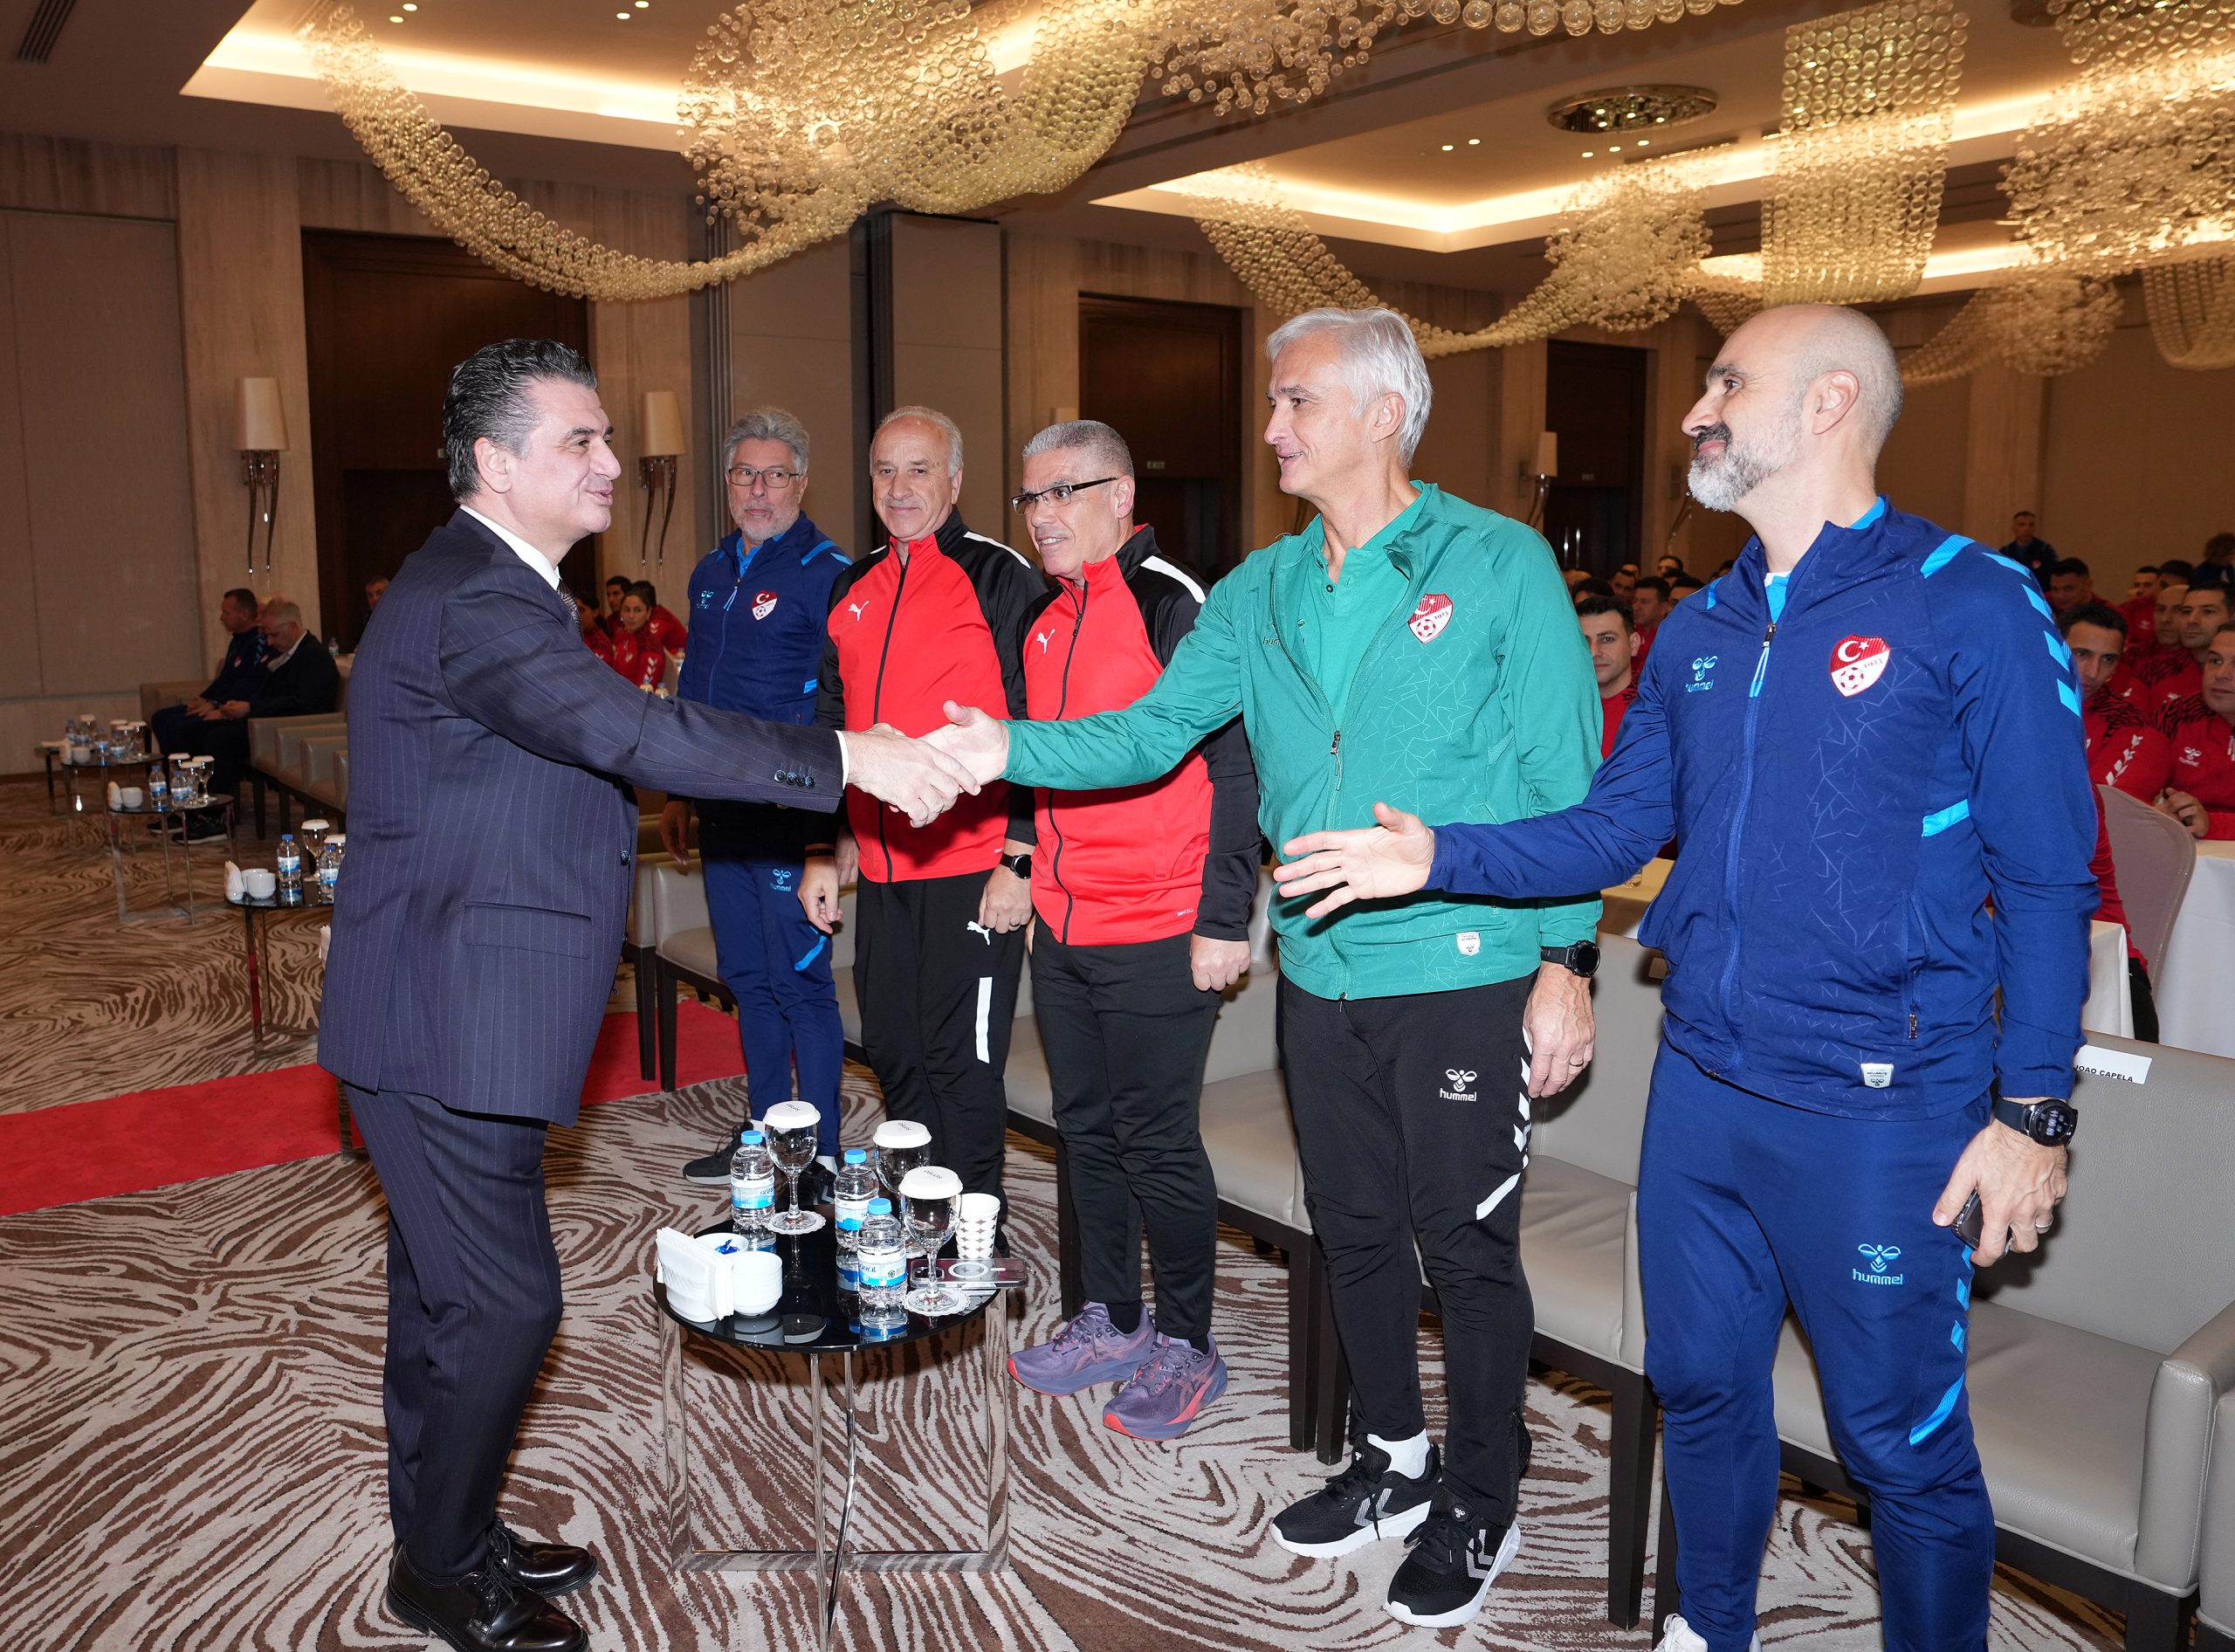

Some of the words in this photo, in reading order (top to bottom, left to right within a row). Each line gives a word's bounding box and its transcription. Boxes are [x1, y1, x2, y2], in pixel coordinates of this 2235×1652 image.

[2073, 1064, 2097, 1075] JOAO
[2099, 1070, 2133, 1083] CAPELA
[1440, 1088, 1477, 1102] hummel
[1853, 1268, 1903, 1285] hummel
